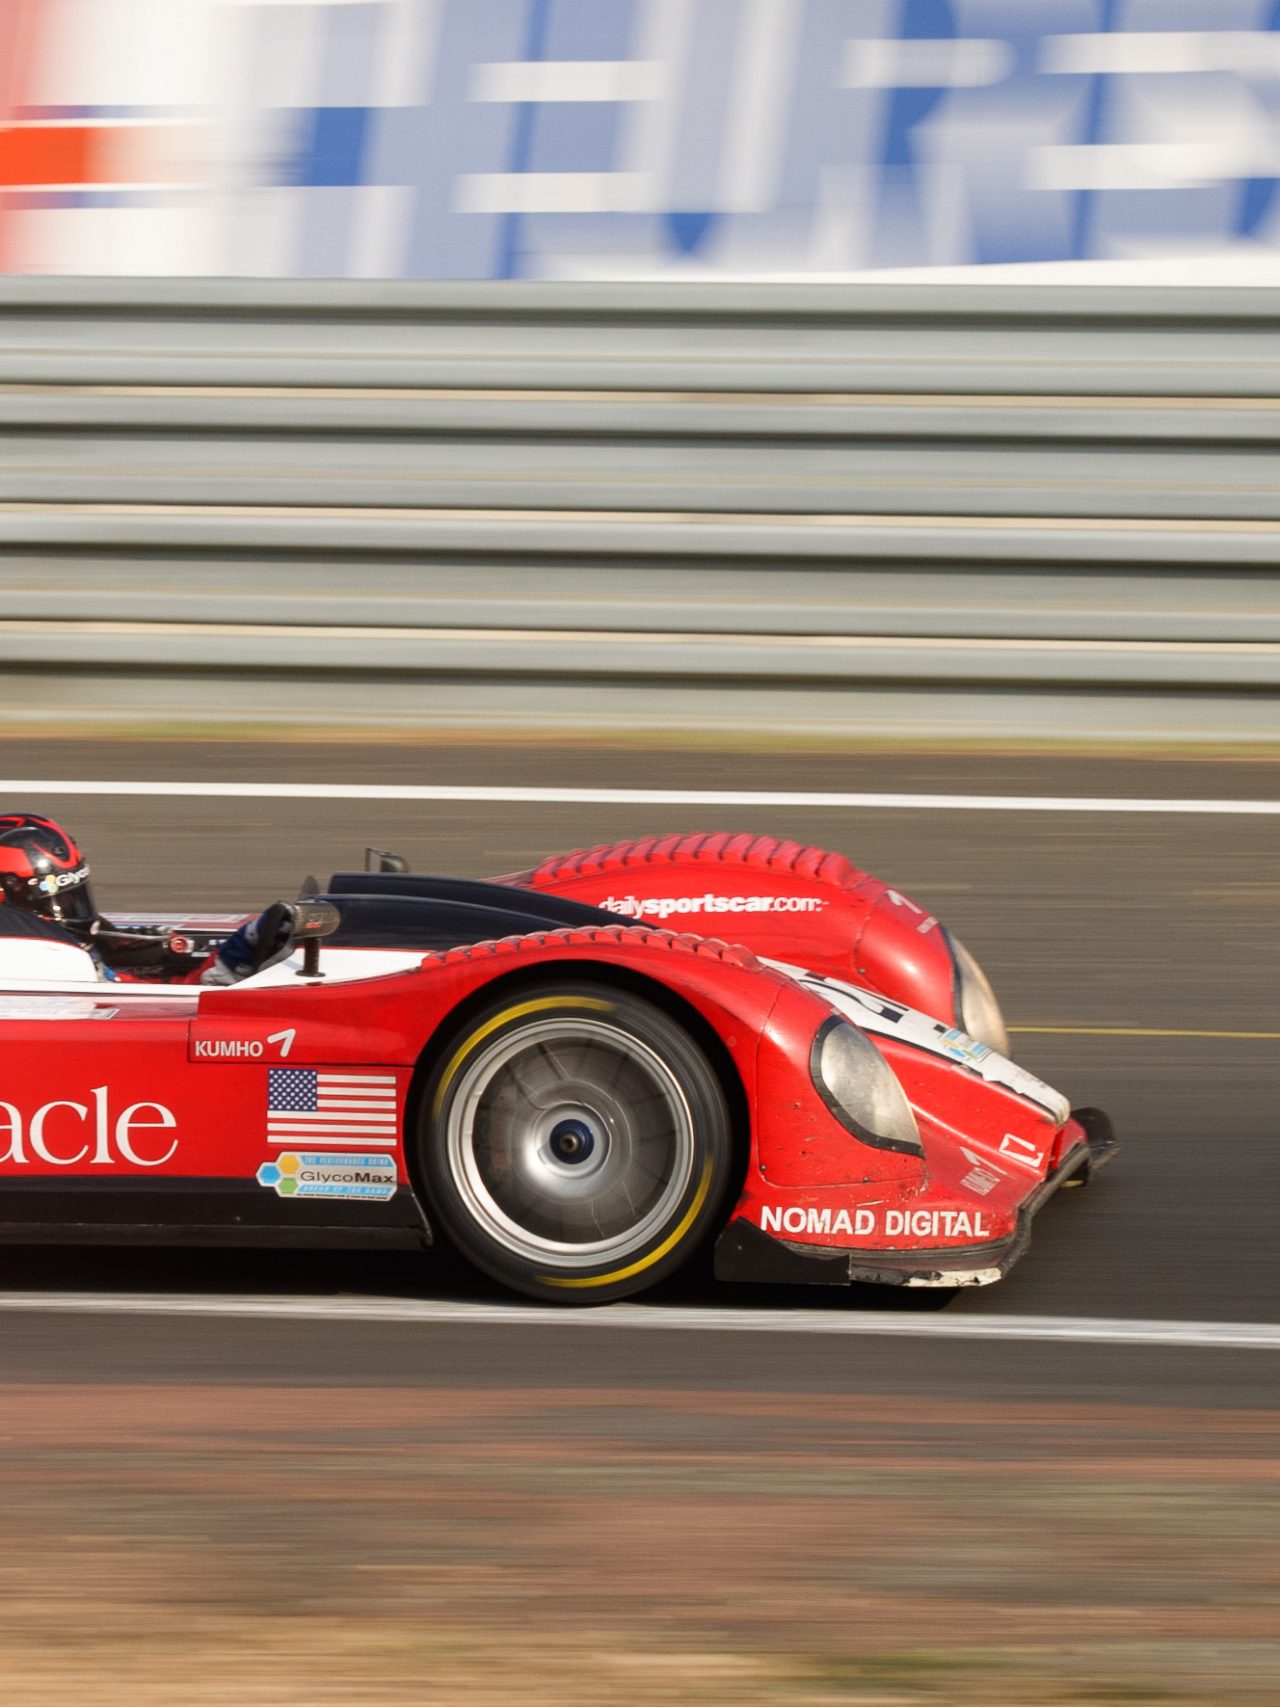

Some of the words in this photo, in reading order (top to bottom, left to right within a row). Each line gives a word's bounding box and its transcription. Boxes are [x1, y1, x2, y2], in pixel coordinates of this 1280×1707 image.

[194, 1040, 263, 1057] KUMHO
[300, 1170, 395, 1184] GlycoMax
[760, 1205, 875, 1236] NOMAD
[885, 1210, 990, 1238] DIGITAL
